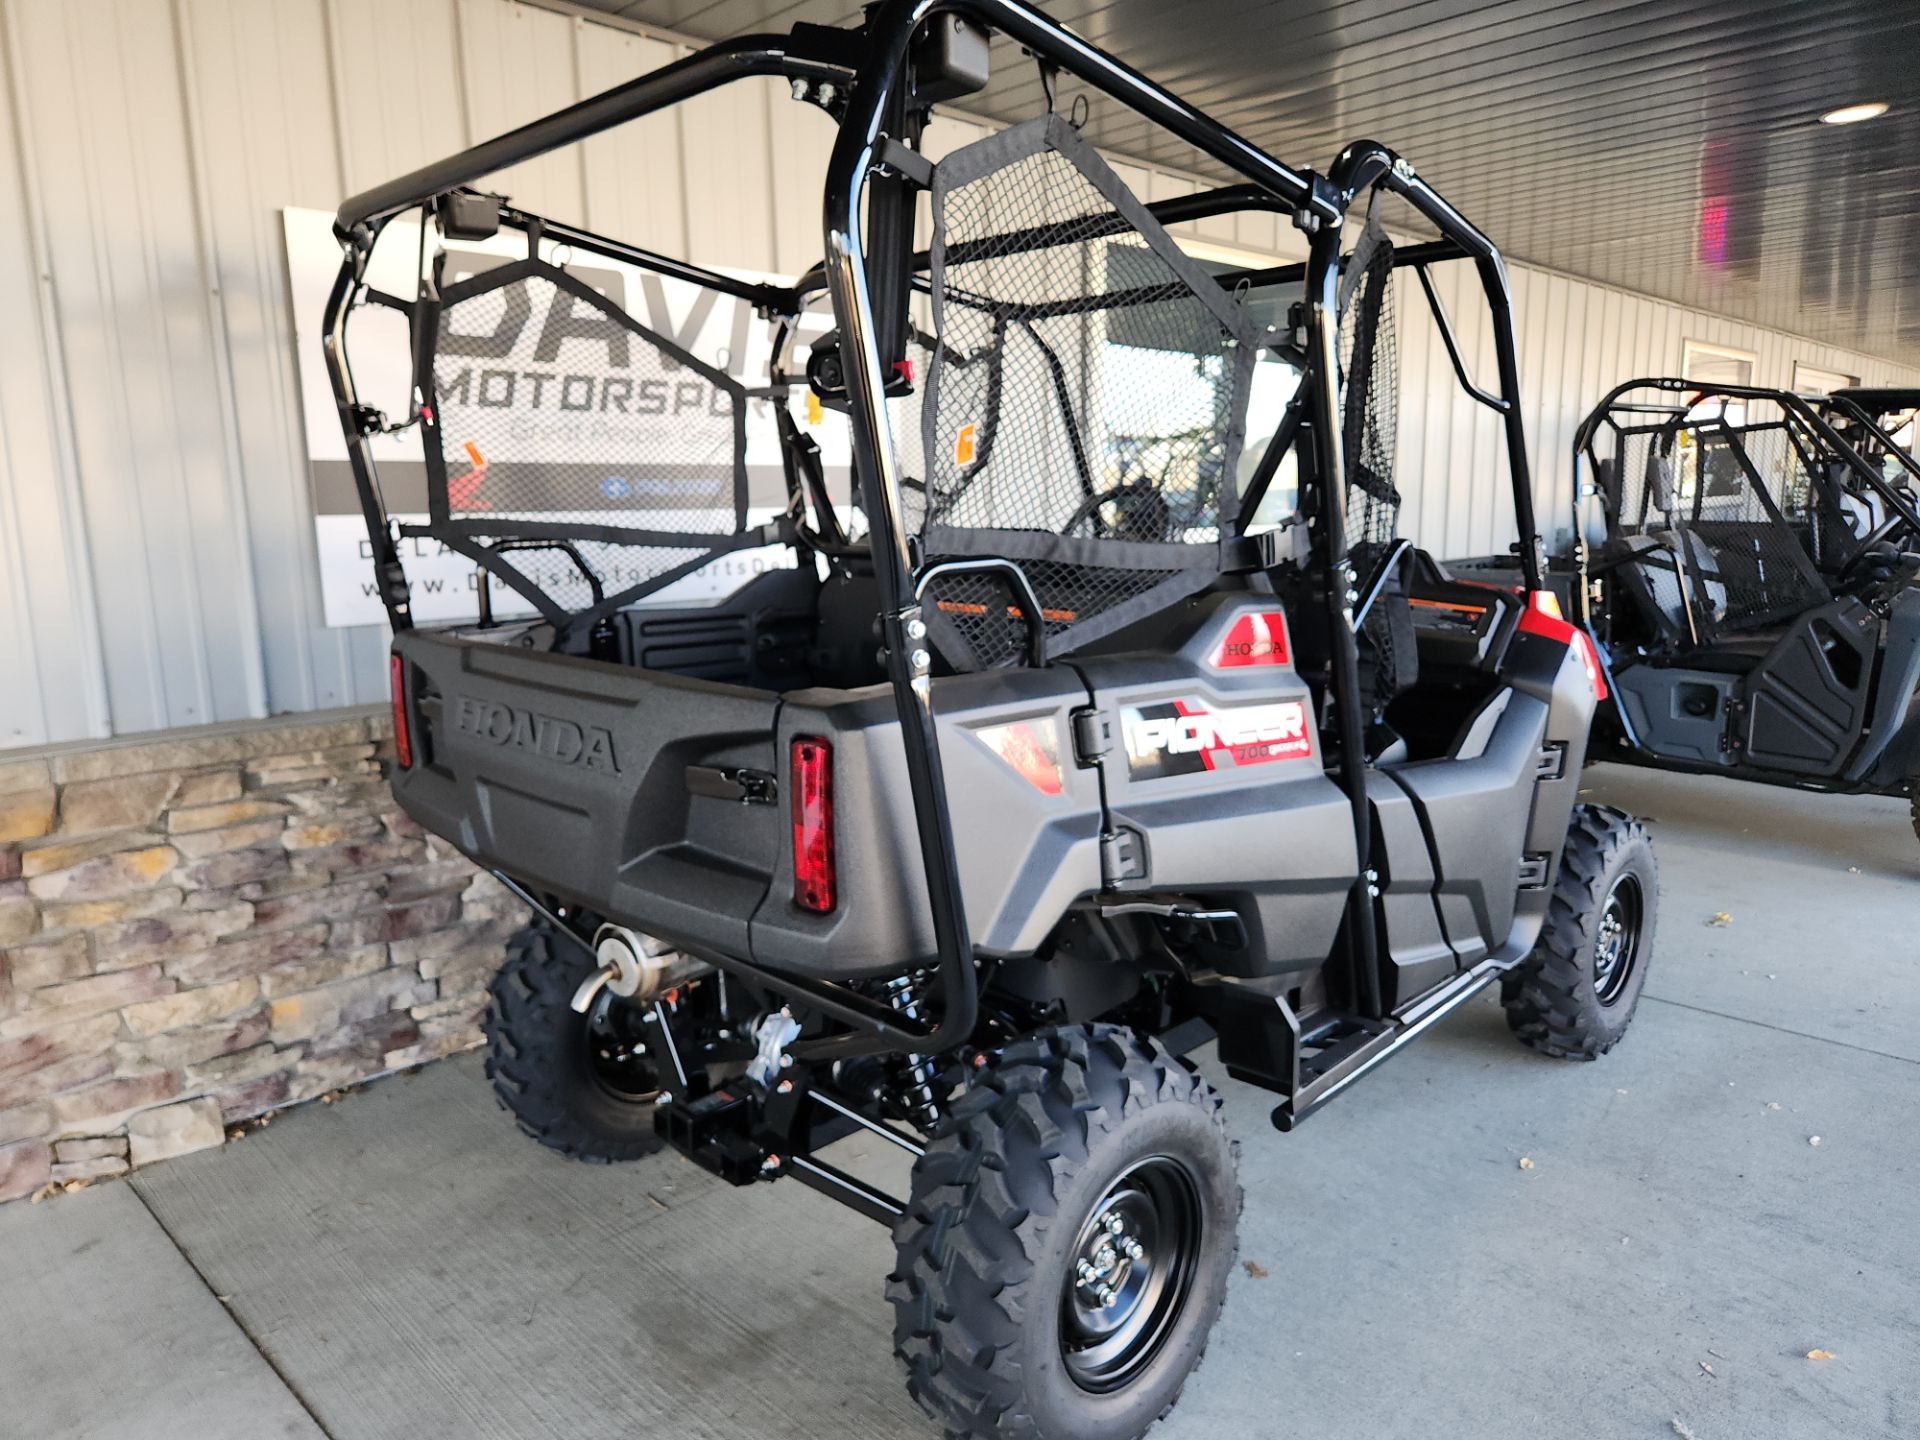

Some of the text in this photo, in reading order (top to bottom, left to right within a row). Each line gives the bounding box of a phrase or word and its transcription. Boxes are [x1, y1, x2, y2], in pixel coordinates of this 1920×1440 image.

[432, 368, 820, 421] MOTORSPO
[457, 695, 622, 777] HONDA
[1134, 703, 1303, 757] PIONEER
[1237, 745, 1269, 761] 700
